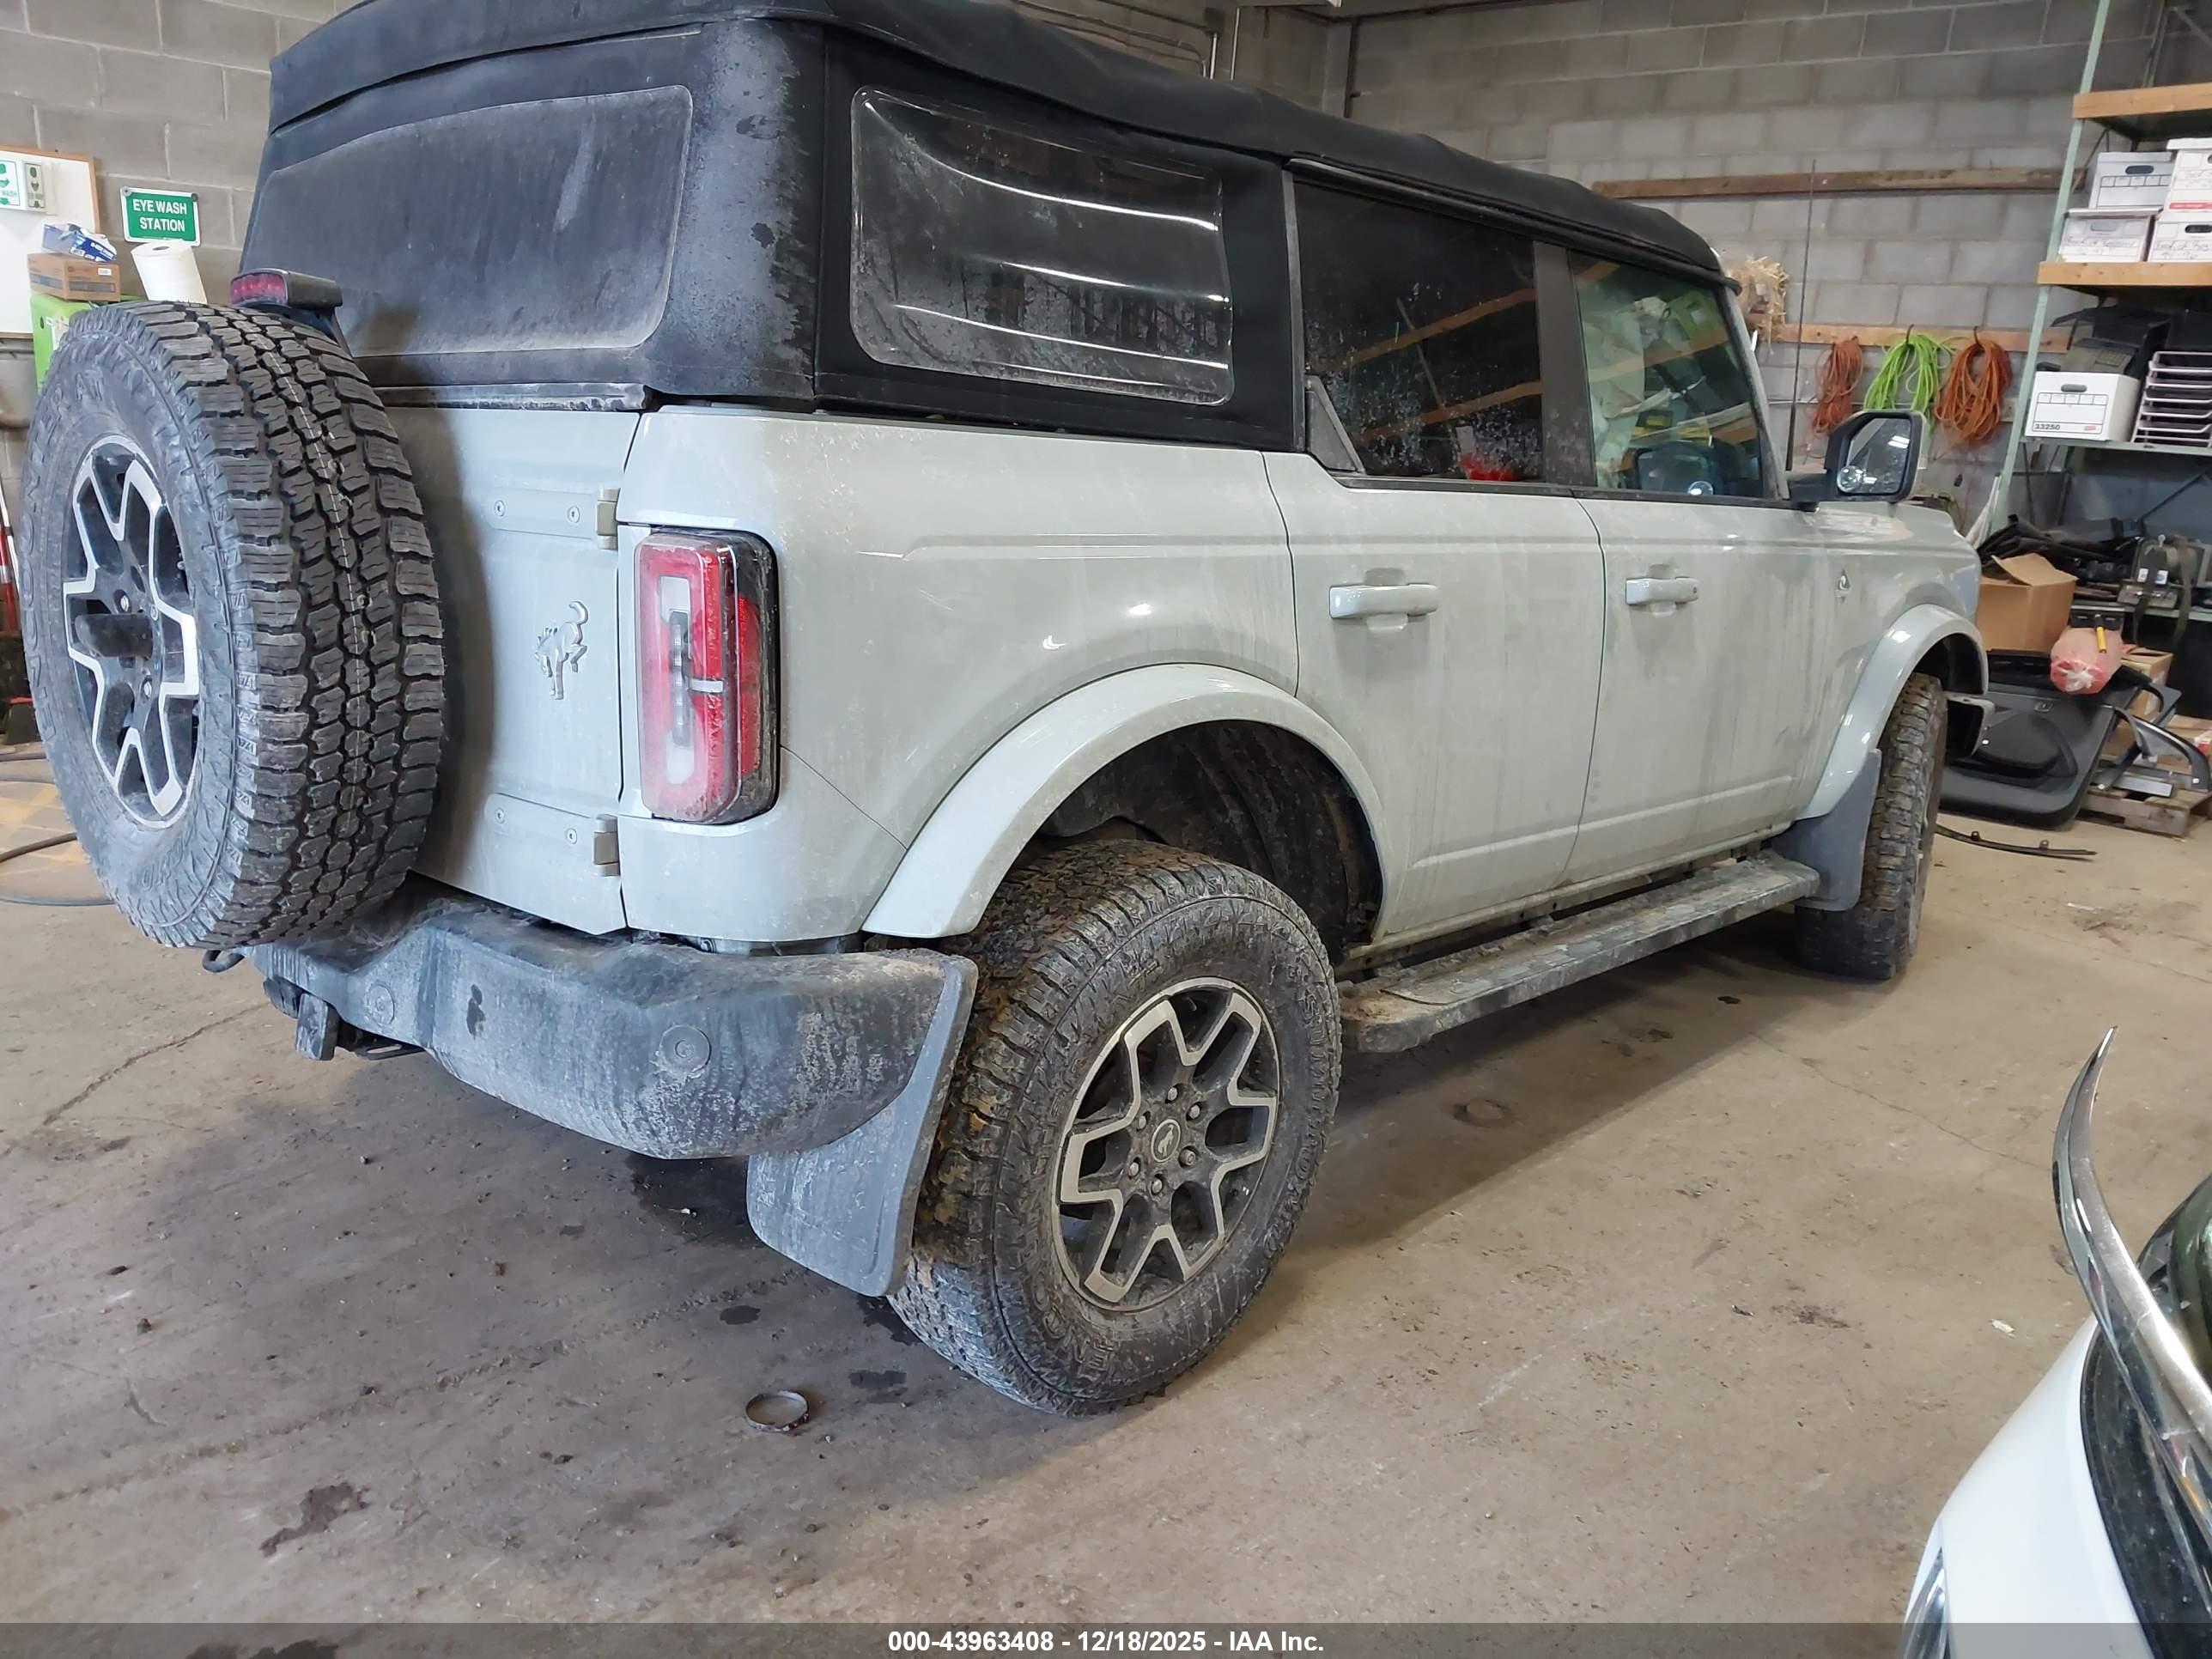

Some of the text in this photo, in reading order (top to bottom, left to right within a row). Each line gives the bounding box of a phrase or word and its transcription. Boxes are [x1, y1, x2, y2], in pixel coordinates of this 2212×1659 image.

[132, 198, 187, 215] EYE WASH
[139, 216, 185, 232] STATION
